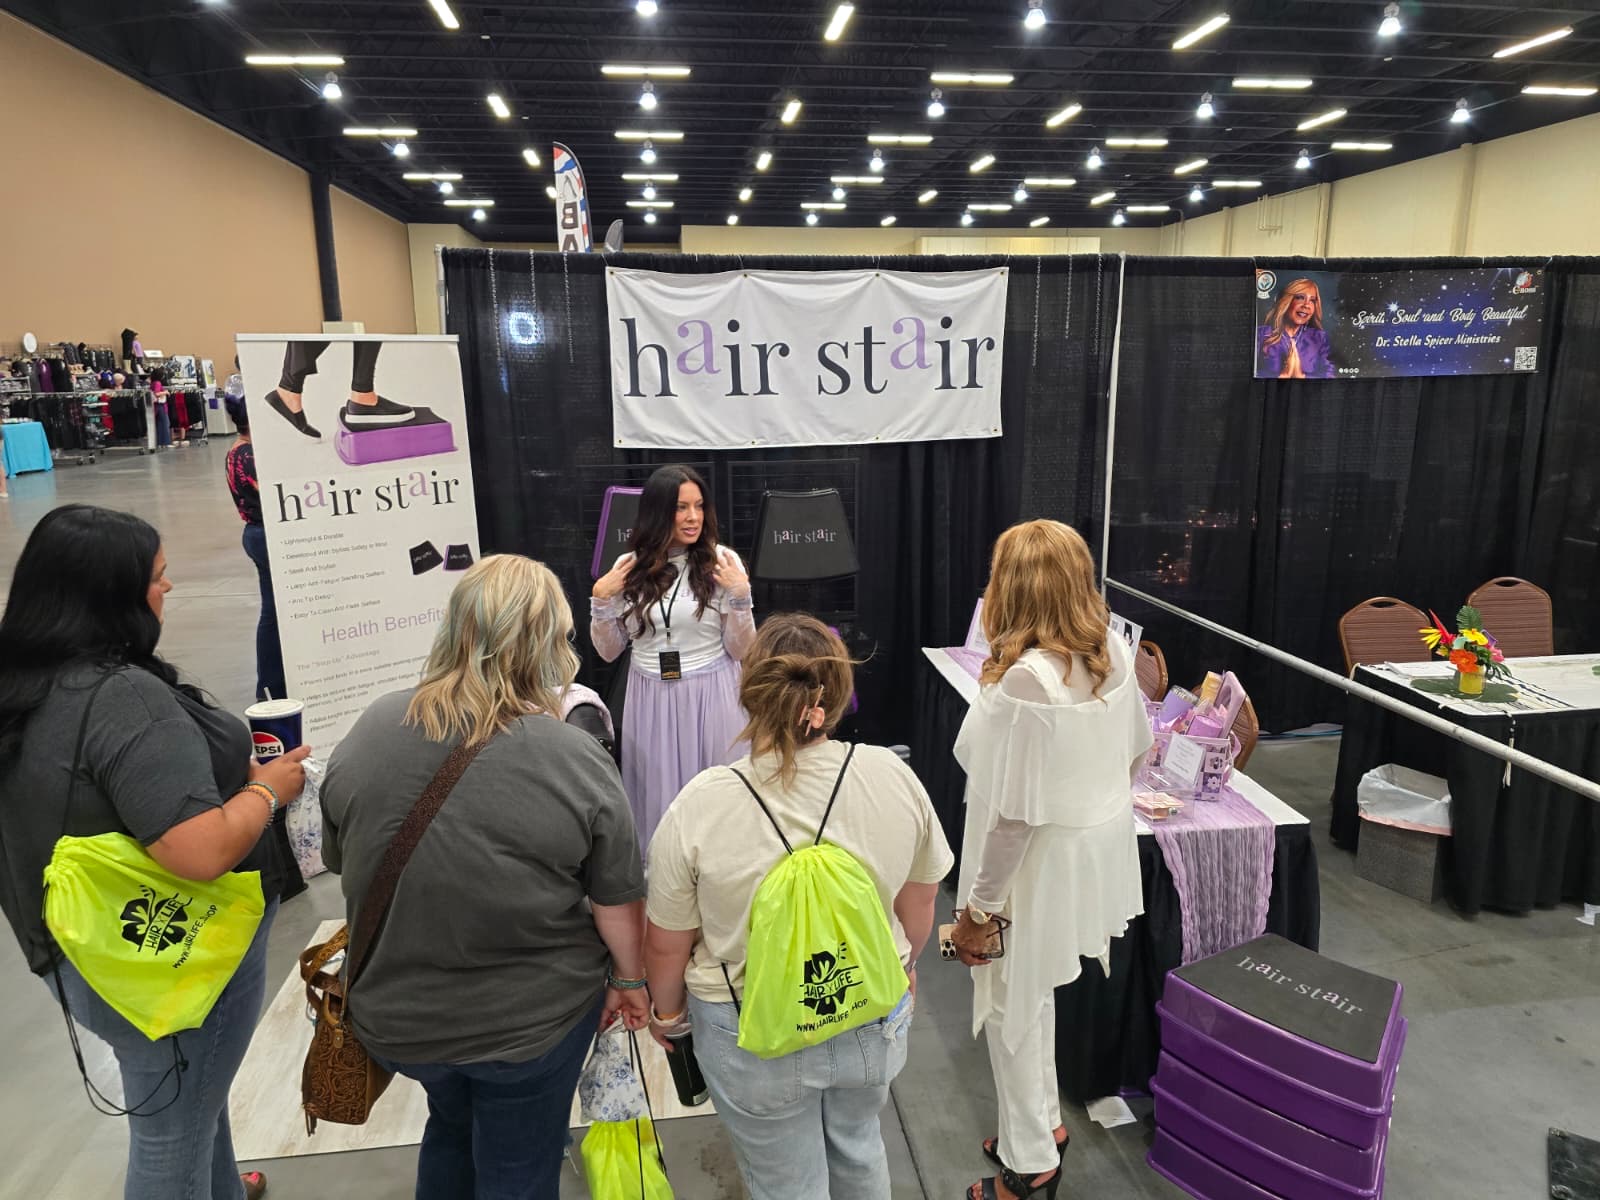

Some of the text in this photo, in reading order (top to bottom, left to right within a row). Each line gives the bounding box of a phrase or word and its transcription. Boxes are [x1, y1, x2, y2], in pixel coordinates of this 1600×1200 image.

[1392, 309, 1422, 325] Soul
[1423, 310, 1446, 322] and
[1449, 308, 1476, 328] Body
[1481, 305, 1529, 327] Beautiful
[1375, 334, 1502, 348] Dr. Stella Spicer Ministries
[619, 316, 996, 397] hair stair
[273, 470, 460, 523] hair stair
[774, 528, 837, 544] hair stair
[321, 619, 379, 644] Health
[144, 925, 162, 949] HAIR
[833, 971, 853, 990] LIFE
[1236, 956, 1364, 1015] hair stair
